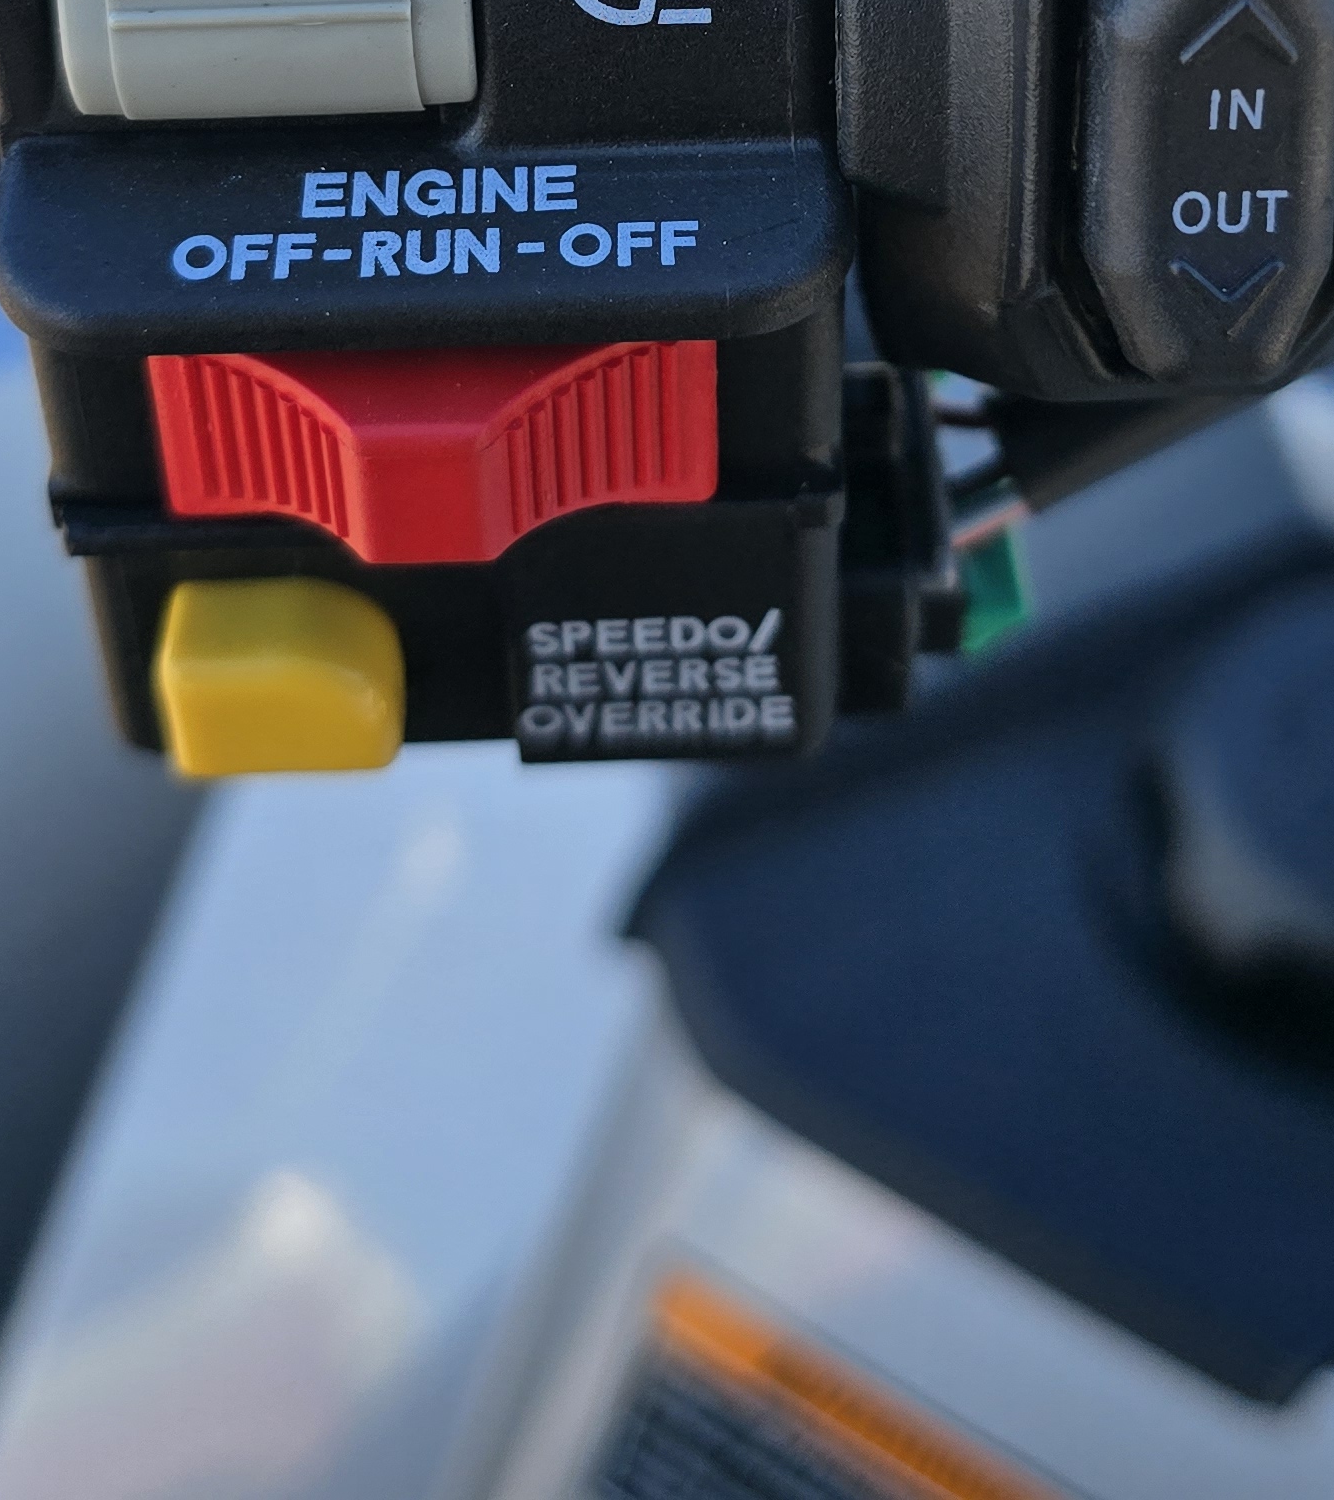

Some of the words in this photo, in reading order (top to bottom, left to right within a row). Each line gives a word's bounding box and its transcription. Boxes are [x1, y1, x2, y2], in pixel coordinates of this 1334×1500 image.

[1208, 88, 1266, 131] IN
[301, 164, 578, 219] ENGINE
[1171, 189, 1290, 235] OUT
[527, 606, 783, 658] SPEEDO/
[530, 654, 779, 699] REVERSE
[520, 695, 794, 738] OVERRIDE
